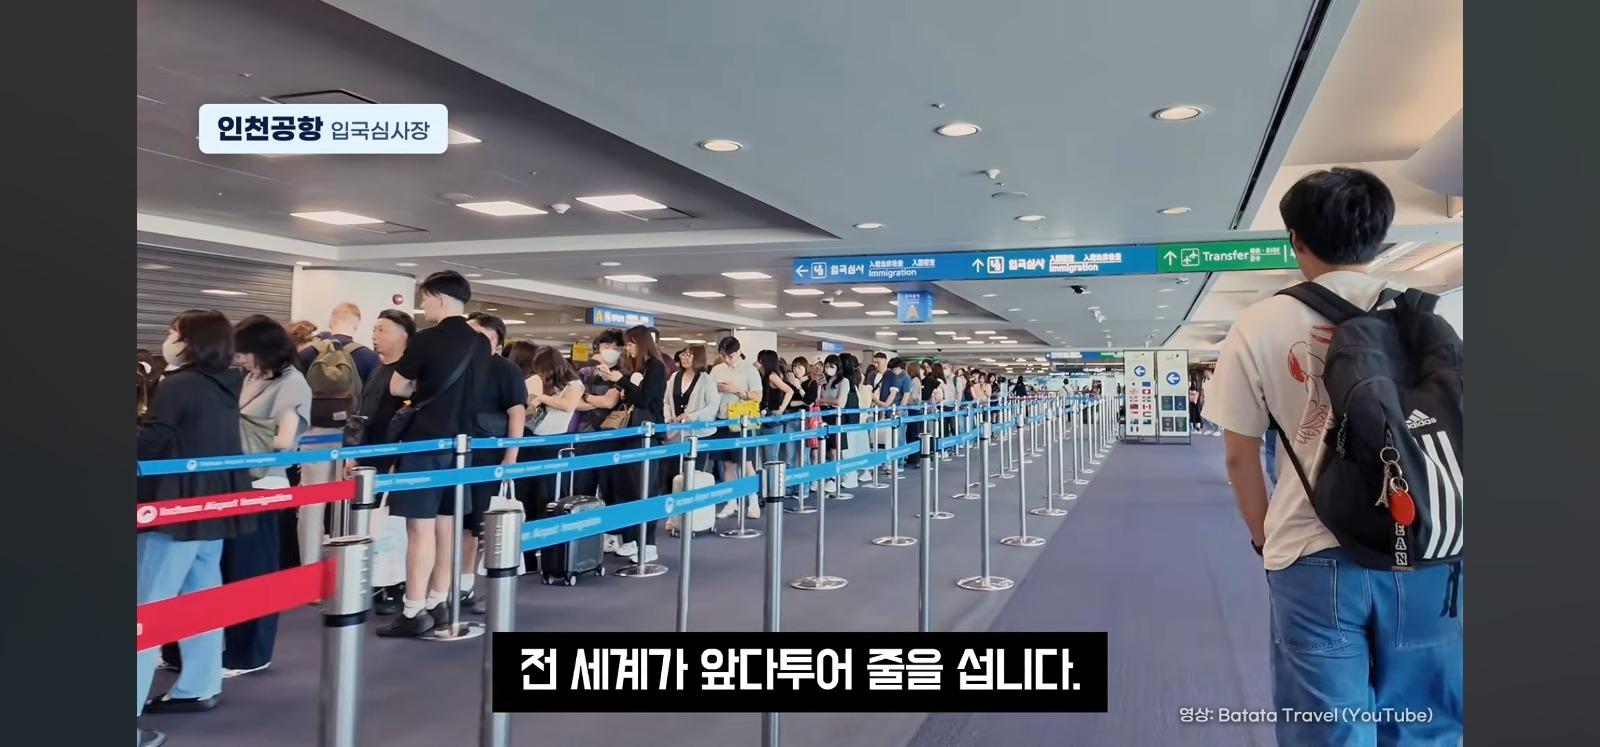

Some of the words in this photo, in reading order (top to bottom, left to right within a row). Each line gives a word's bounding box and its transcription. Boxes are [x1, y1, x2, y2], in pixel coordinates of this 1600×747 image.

[1202, 250, 1250, 262] Transfer
[869, 268, 917, 278] Immigration
[1049, 261, 1099, 273] Immigration
